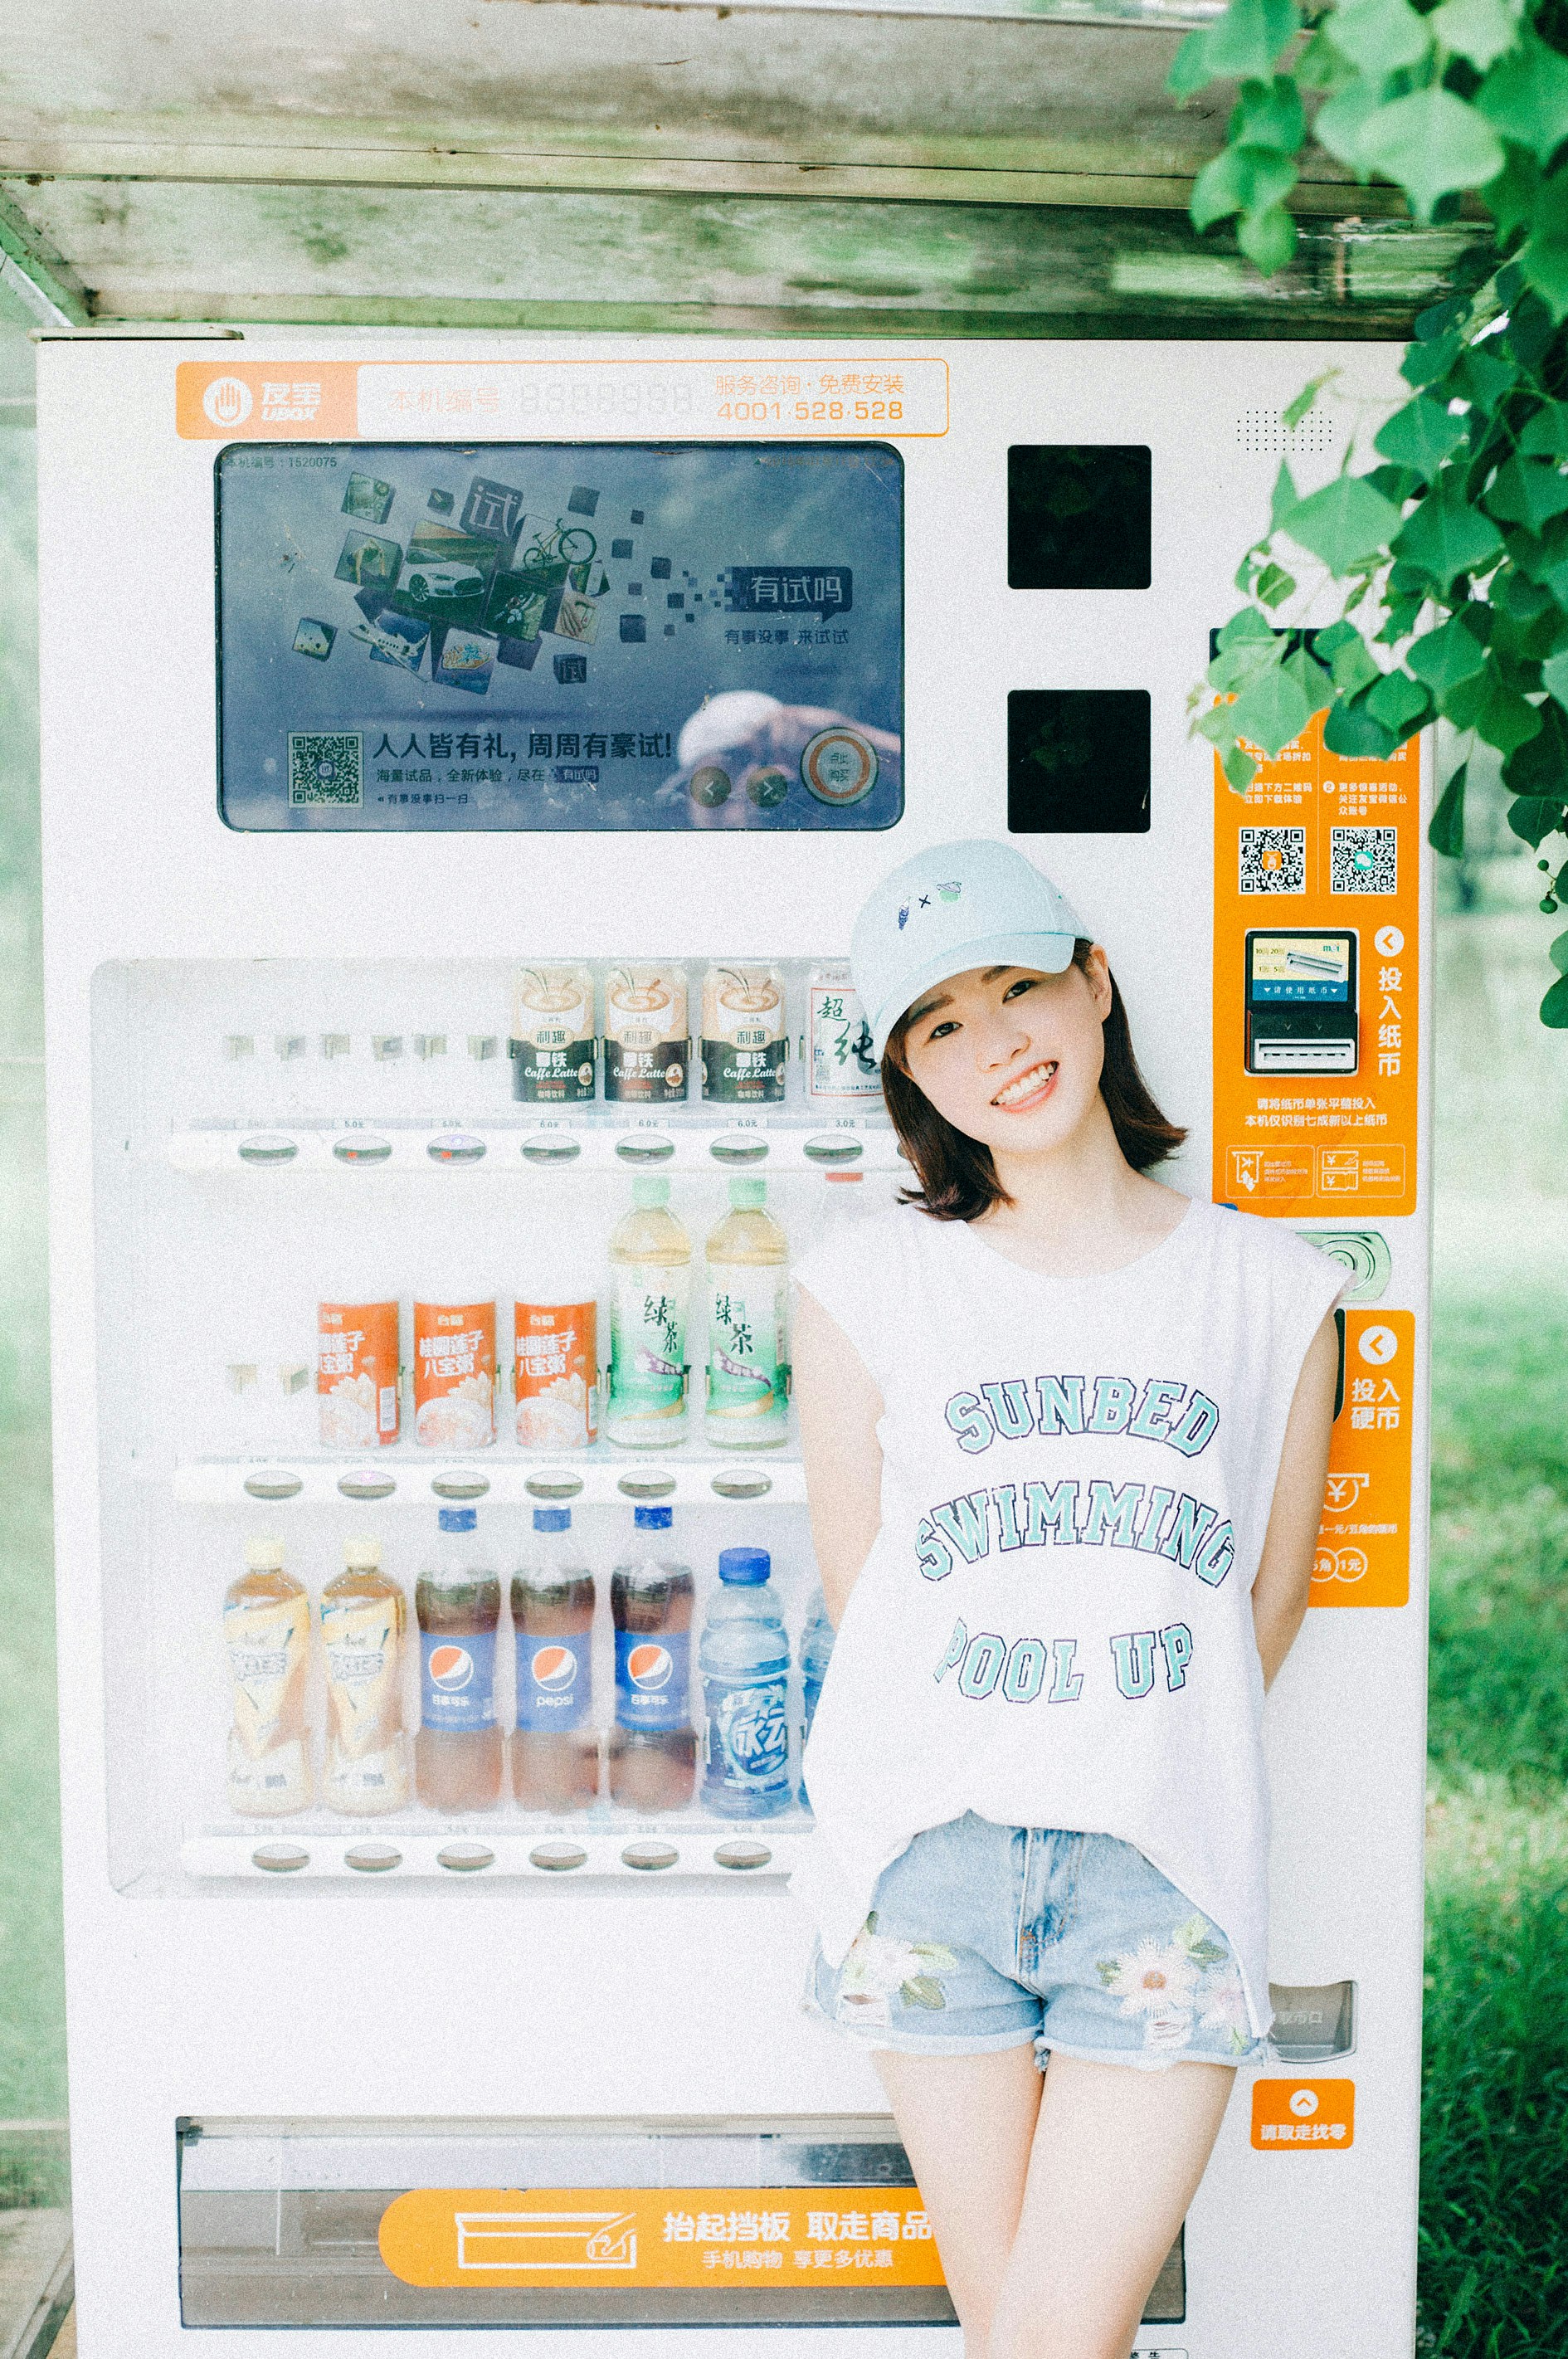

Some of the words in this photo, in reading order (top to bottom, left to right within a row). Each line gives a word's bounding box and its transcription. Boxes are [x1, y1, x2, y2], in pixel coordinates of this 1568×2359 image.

[389, 386, 499, 412] 本机编号
[751, 575, 843, 603] 有试吗
[724, 628, 789, 646] 有事没事
[798, 628, 850, 646] 来试试
[1377, 966, 1403, 1078] 投入纸币
[1244, 1114, 1388, 1128] 本机仅识别七成新以上纸币
[1351, 1377, 1401, 1403] 投入
[944, 1374, 1220, 1459] SUNBED
[1350, 1406, 1400, 1431] 硬币
[914, 1479, 1236, 1589] SWIMMING
[1339, 1558, 1362, 1572] 1元
[933, 1616, 1084, 1703] POOL
[1109, 1622, 1194, 1700] UP
[536, 1694, 574, 1708] pepsi
[1260, 2123, 1346, 2142] 请取走找零
[663, 2211, 791, 2243] 抬起挡板
[806, 2210, 933, 2242] 取走商品
[702, 2249, 784, 2269] 手机购物
[793, 2249, 894, 2269] 享更多优惠
